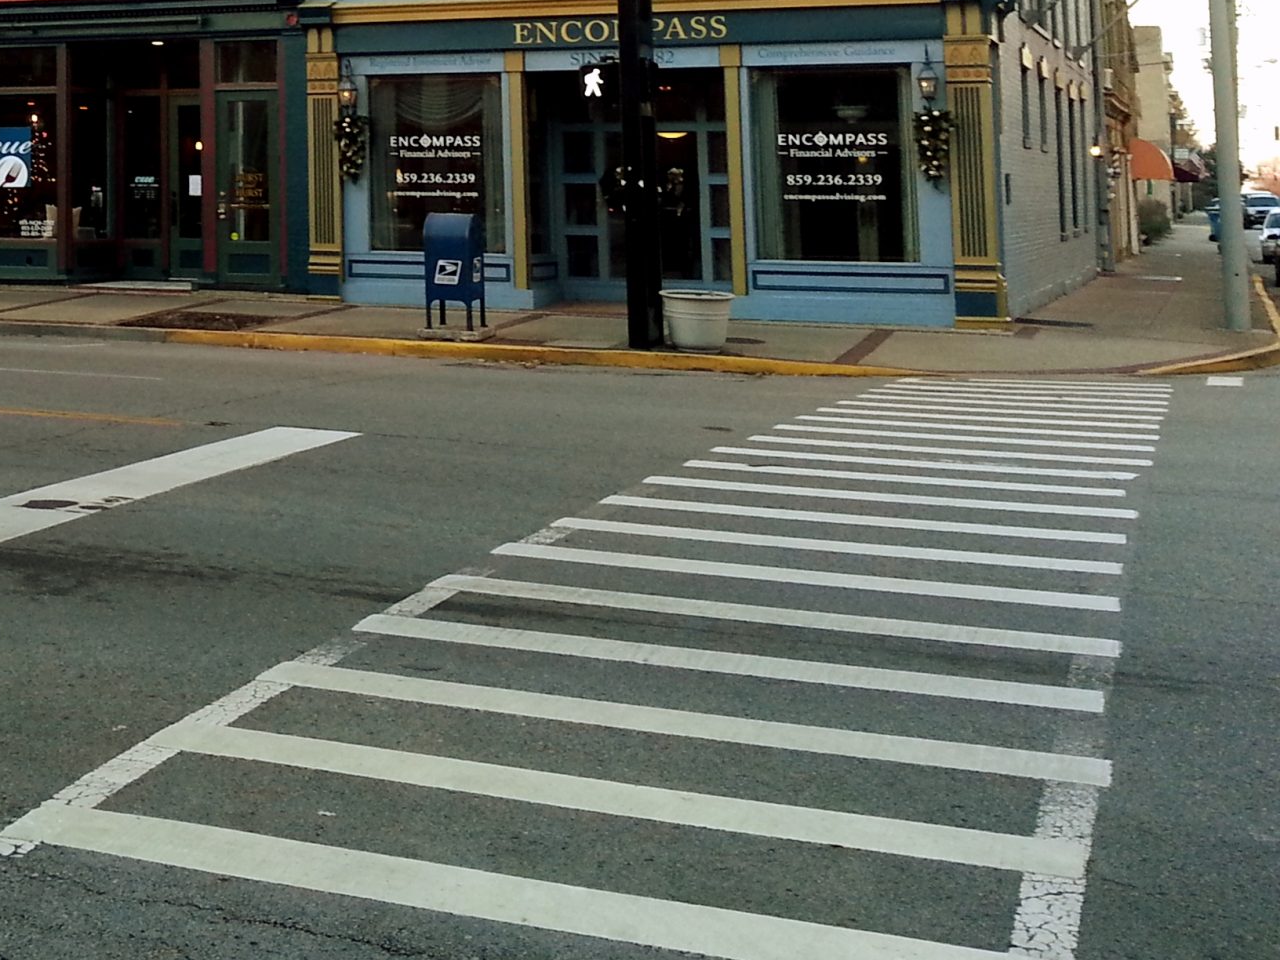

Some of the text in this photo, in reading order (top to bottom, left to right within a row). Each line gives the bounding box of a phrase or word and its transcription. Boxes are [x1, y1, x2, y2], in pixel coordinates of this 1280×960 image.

[513, 15, 728, 44] ENCOPASS
[389, 134, 481, 148] ENCOMPASS
[777, 131, 888, 146] ENCOMPASS
[400, 149, 472, 158] Financial Advisors
[790, 148, 876, 157] Financial Advisors
[396, 173, 476, 183] 859.236.2339
[786, 174, 883, 185] 859.236.2339
